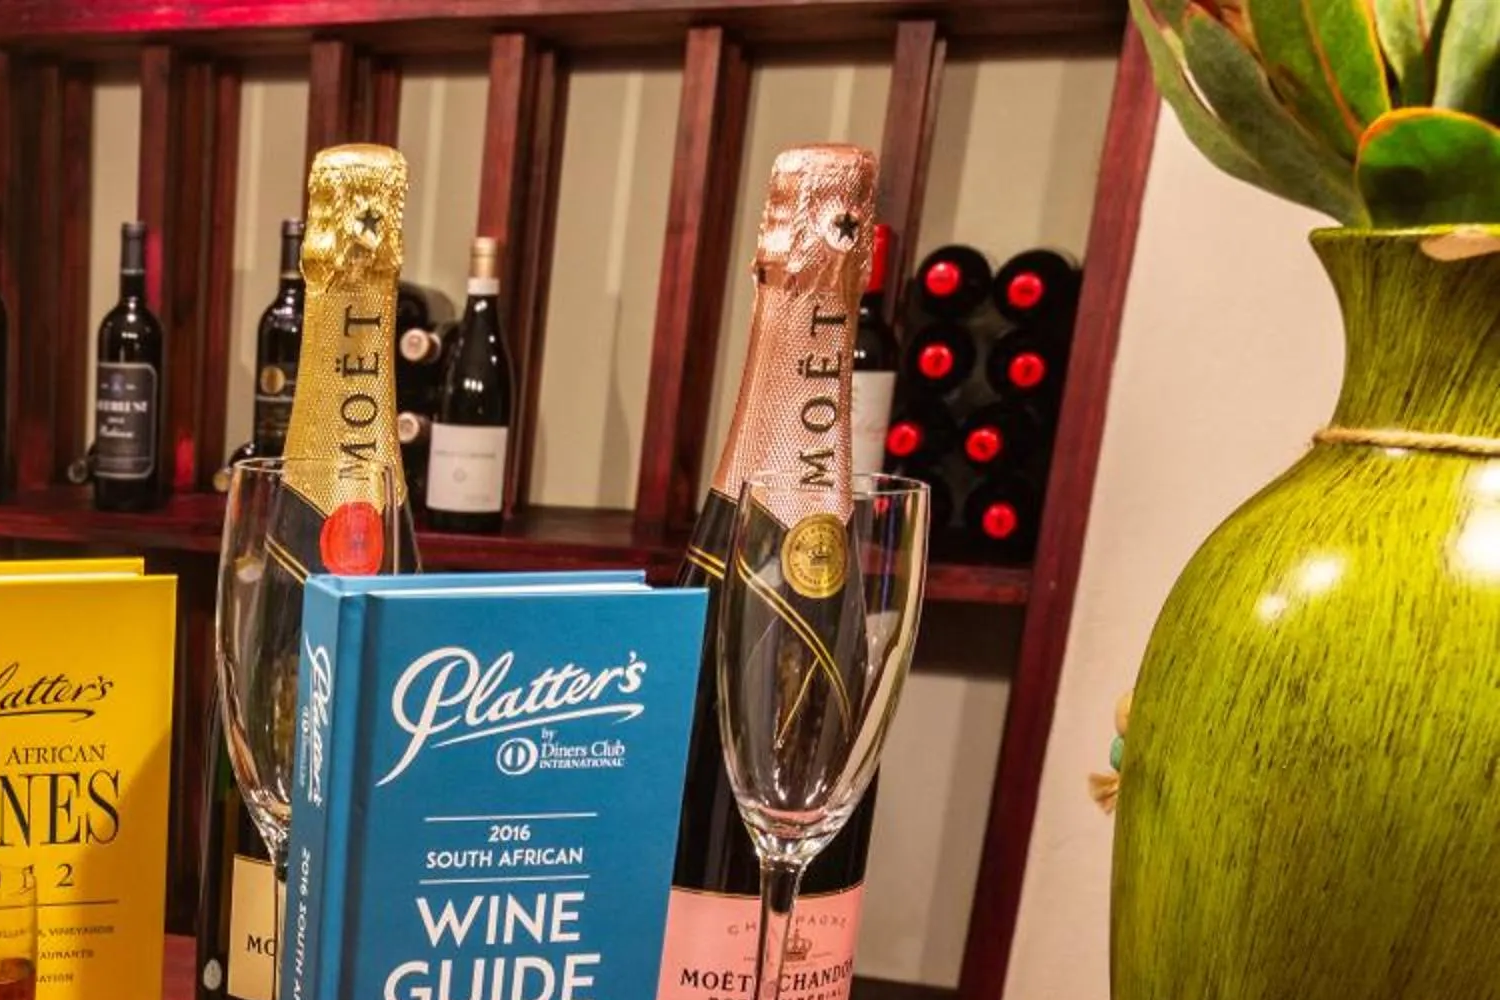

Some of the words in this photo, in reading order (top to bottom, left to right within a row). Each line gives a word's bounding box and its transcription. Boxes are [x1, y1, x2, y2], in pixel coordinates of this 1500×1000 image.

[335, 305, 383, 481] MOËT
[798, 305, 848, 489] MOËT
[375, 645, 647, 787] Platter's
[541, 727, 557, 740] by
[4, 744, 106, 767] AFRICAN
[541, 742, 587, 758] Diners
[591, 739, 625, 757] Club
[540, 758, 626, 769] INTERNATIONAL
[488, 825, 531, 843] 2016
[426, 849, 492, 870] SOUTH
[499, 847, 583, 867] AFRICAN
[416, 891, 585, 948] WINE
[727, 914, 848, 936] CHPAGNE
[295, 900, 308, 976] SOUTH
[680, 968, 752, 993] MOËT
